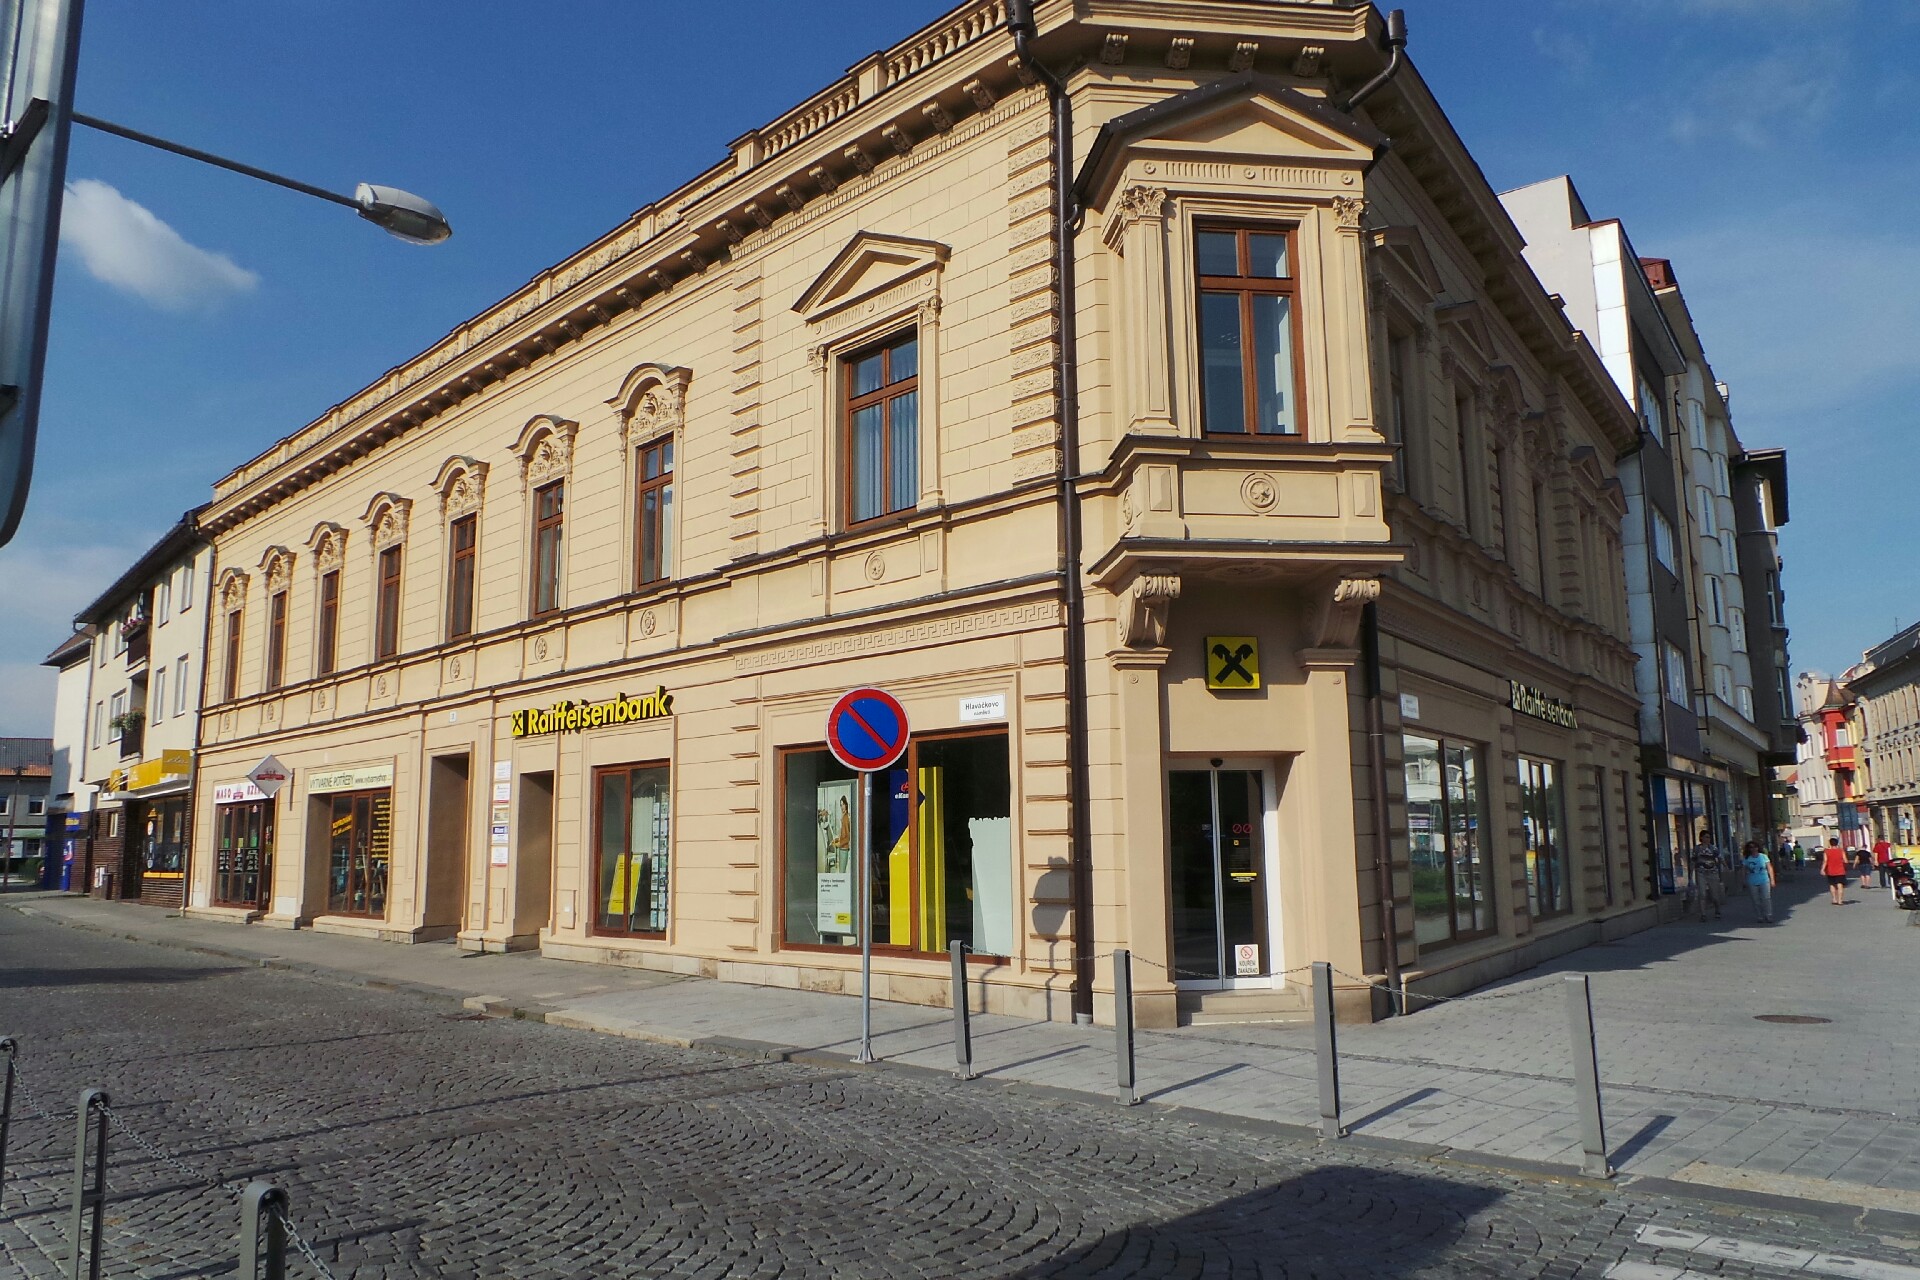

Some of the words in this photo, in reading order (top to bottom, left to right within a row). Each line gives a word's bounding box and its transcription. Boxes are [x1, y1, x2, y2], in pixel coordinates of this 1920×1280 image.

[528, 685, 669, 735] Raiffeisenbank
[965, 701, 1000, 711] Hlaváčkovo
[1520, 684, 1578, 729] Raiffeisenbank
